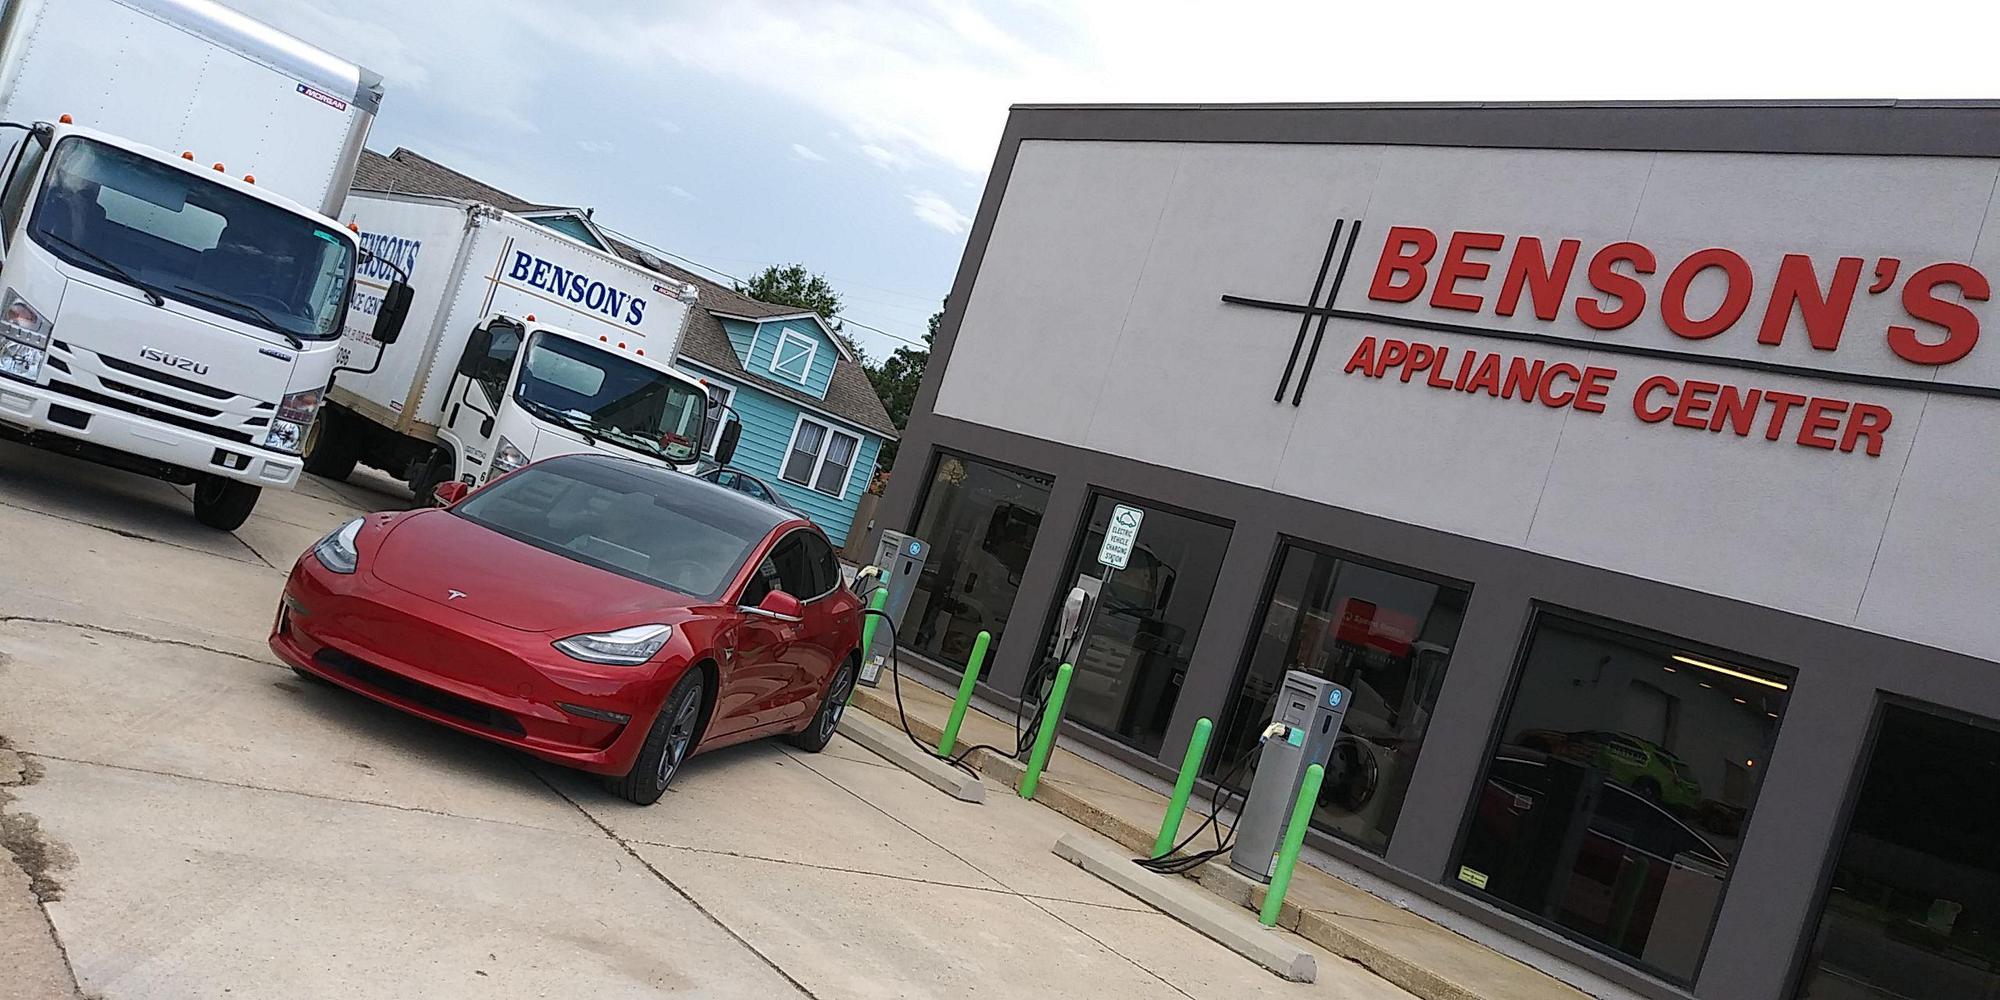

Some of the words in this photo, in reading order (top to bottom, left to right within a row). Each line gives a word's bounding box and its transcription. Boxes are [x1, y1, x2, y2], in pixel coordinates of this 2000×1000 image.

[305, 88, 346, 111] MORGAN
[358, 231, 421, 284] ENSON'S
[508, 250, 647, 326] BENSON'S
[1368, 226, 1990, 366] BENSON'S
[140, 346, 209, 376] ISUZU
[1344, 335, 1618, 414] APPLIANCE
[1632, 375, 1893, 456] CENTER
[1110, 535, 1129, 546] VEHICLE
[1112, 526, 1133, 538] ELECTRIC
[1105, 552, 1123, 563] STATION
[1106, 543, 1128, 555] CHARGING
